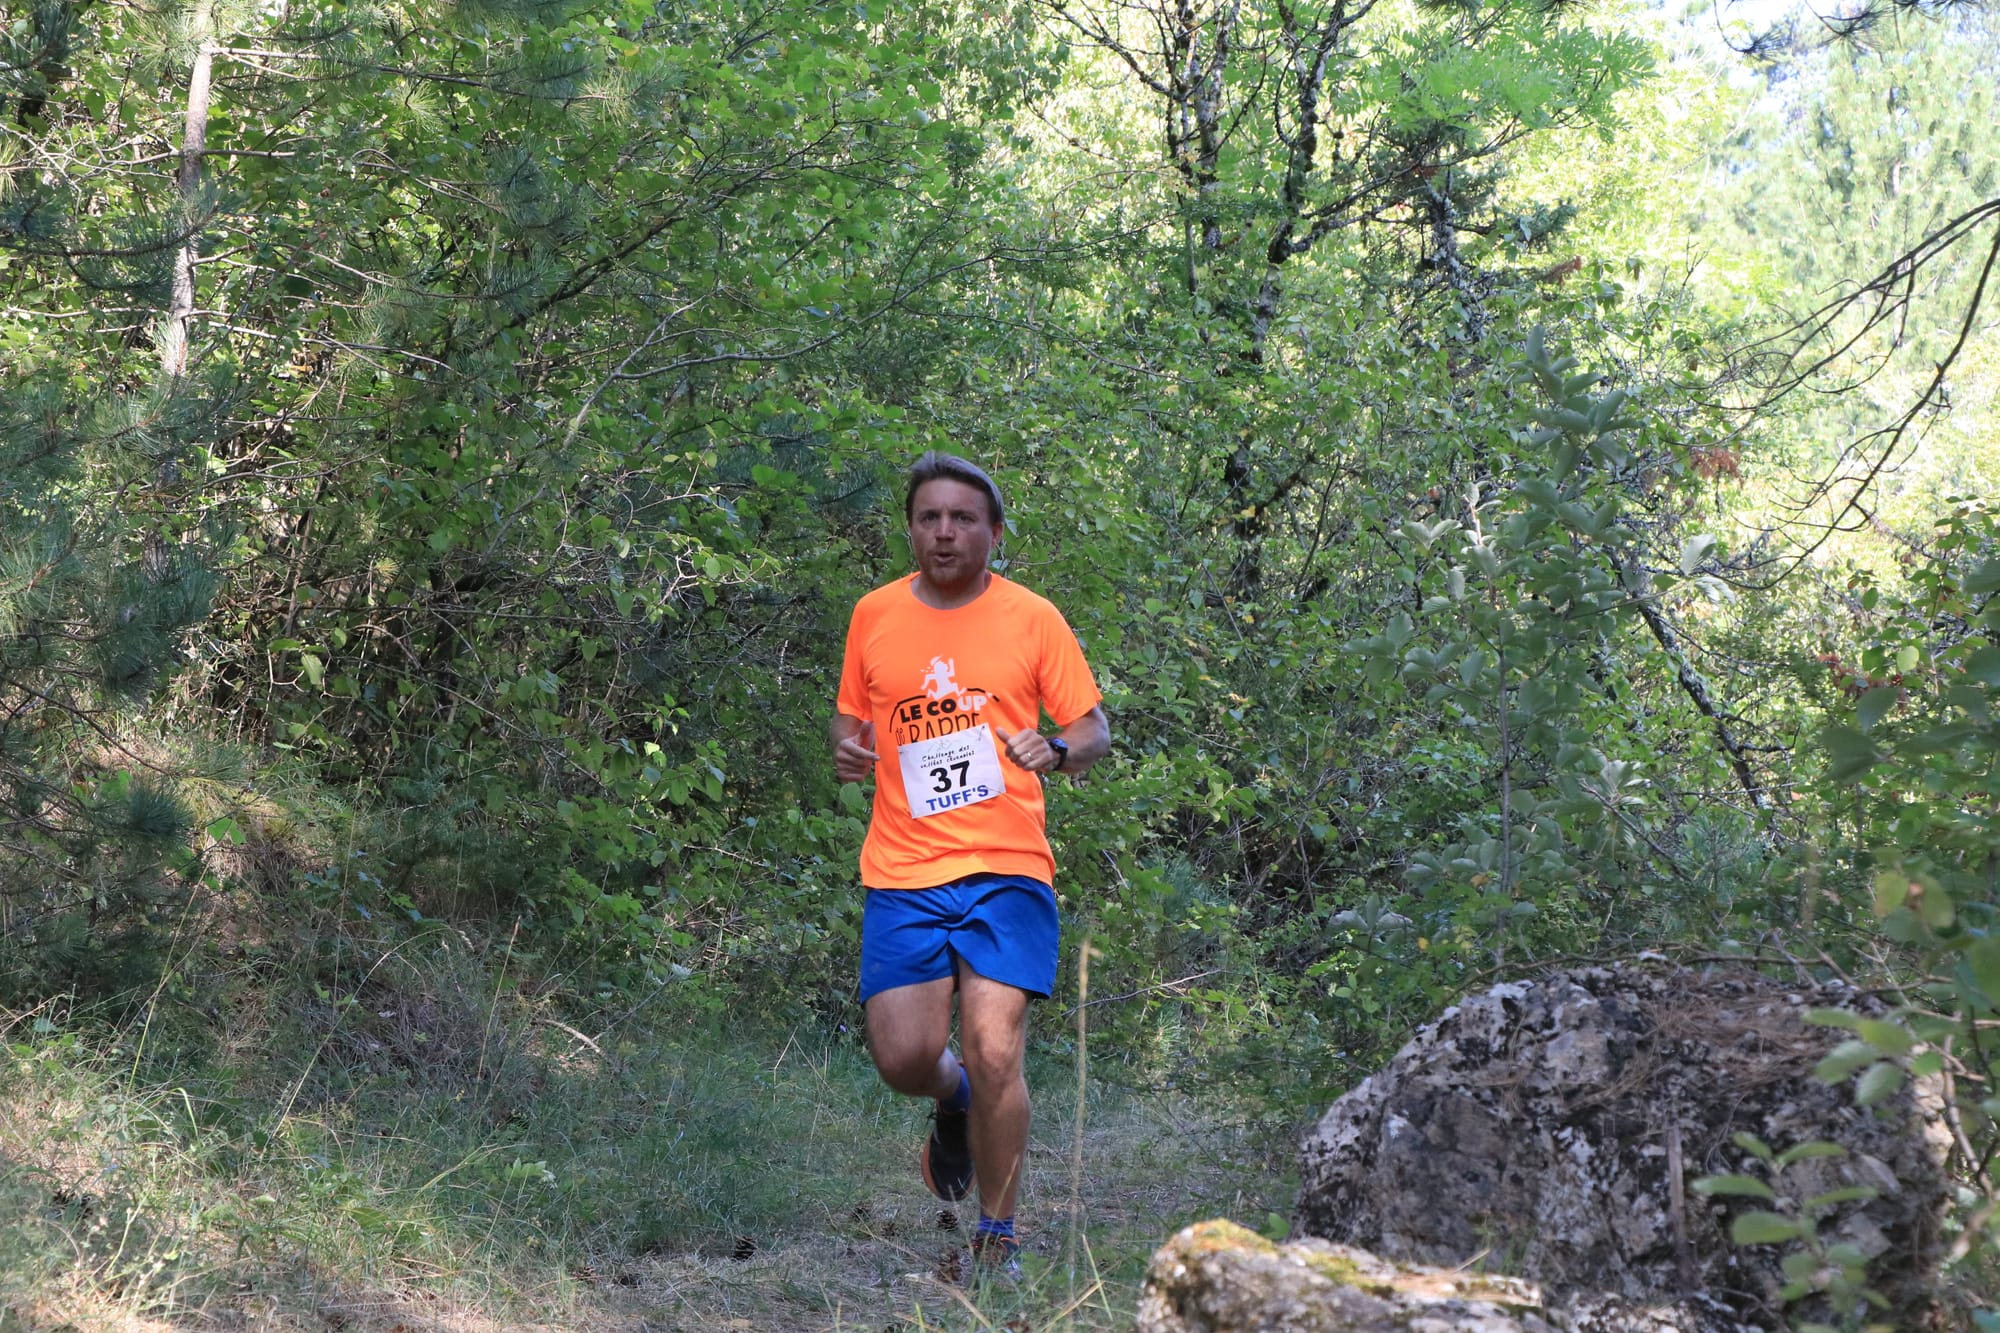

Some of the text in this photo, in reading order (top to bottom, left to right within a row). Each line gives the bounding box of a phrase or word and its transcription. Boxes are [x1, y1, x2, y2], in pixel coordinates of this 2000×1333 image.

[900, 695, 987, 723] LE COUP
[909, 713, 980, 743] BAR
[921, 750, 955, 762] Challenge
[929, 760, 970, 793] 37
[925, 784, 989, 811] TUFF'S
